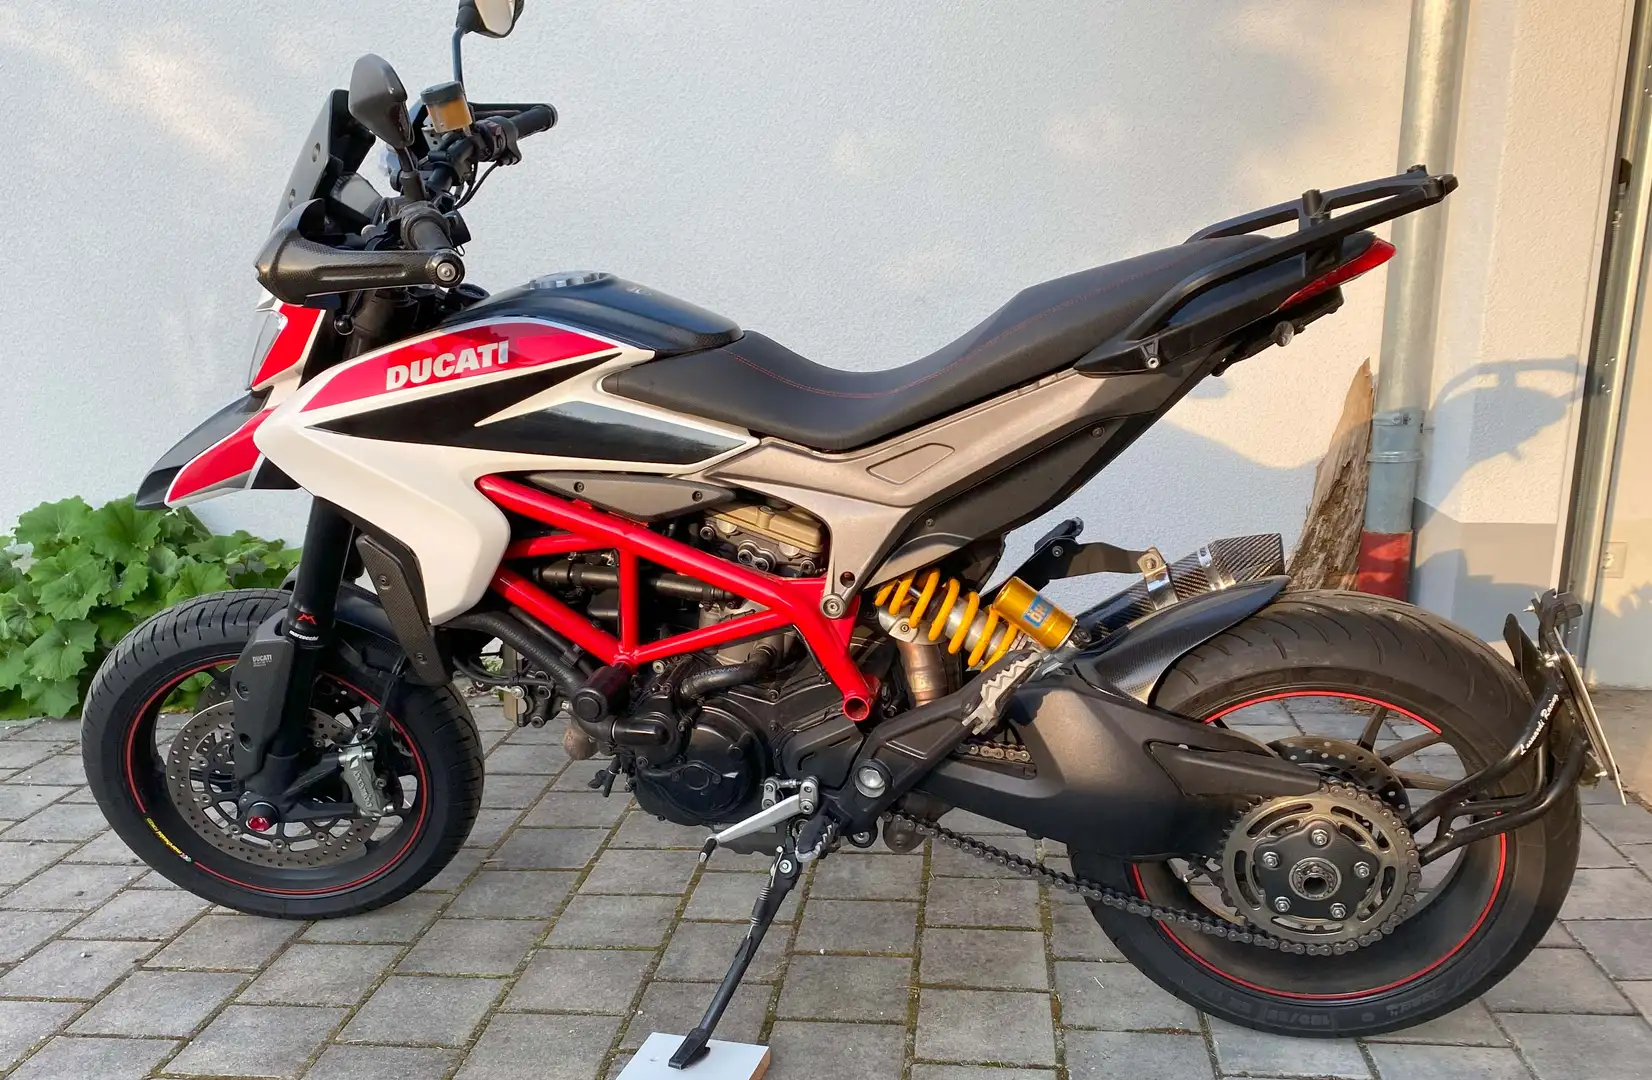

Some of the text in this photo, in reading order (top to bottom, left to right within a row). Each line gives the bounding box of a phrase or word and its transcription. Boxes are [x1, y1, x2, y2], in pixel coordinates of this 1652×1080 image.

[386, 340, 509, 391] DUCATI
[252, 654, 272, 663] DUCATI
[1540, 694, 1559, 720] Racing
